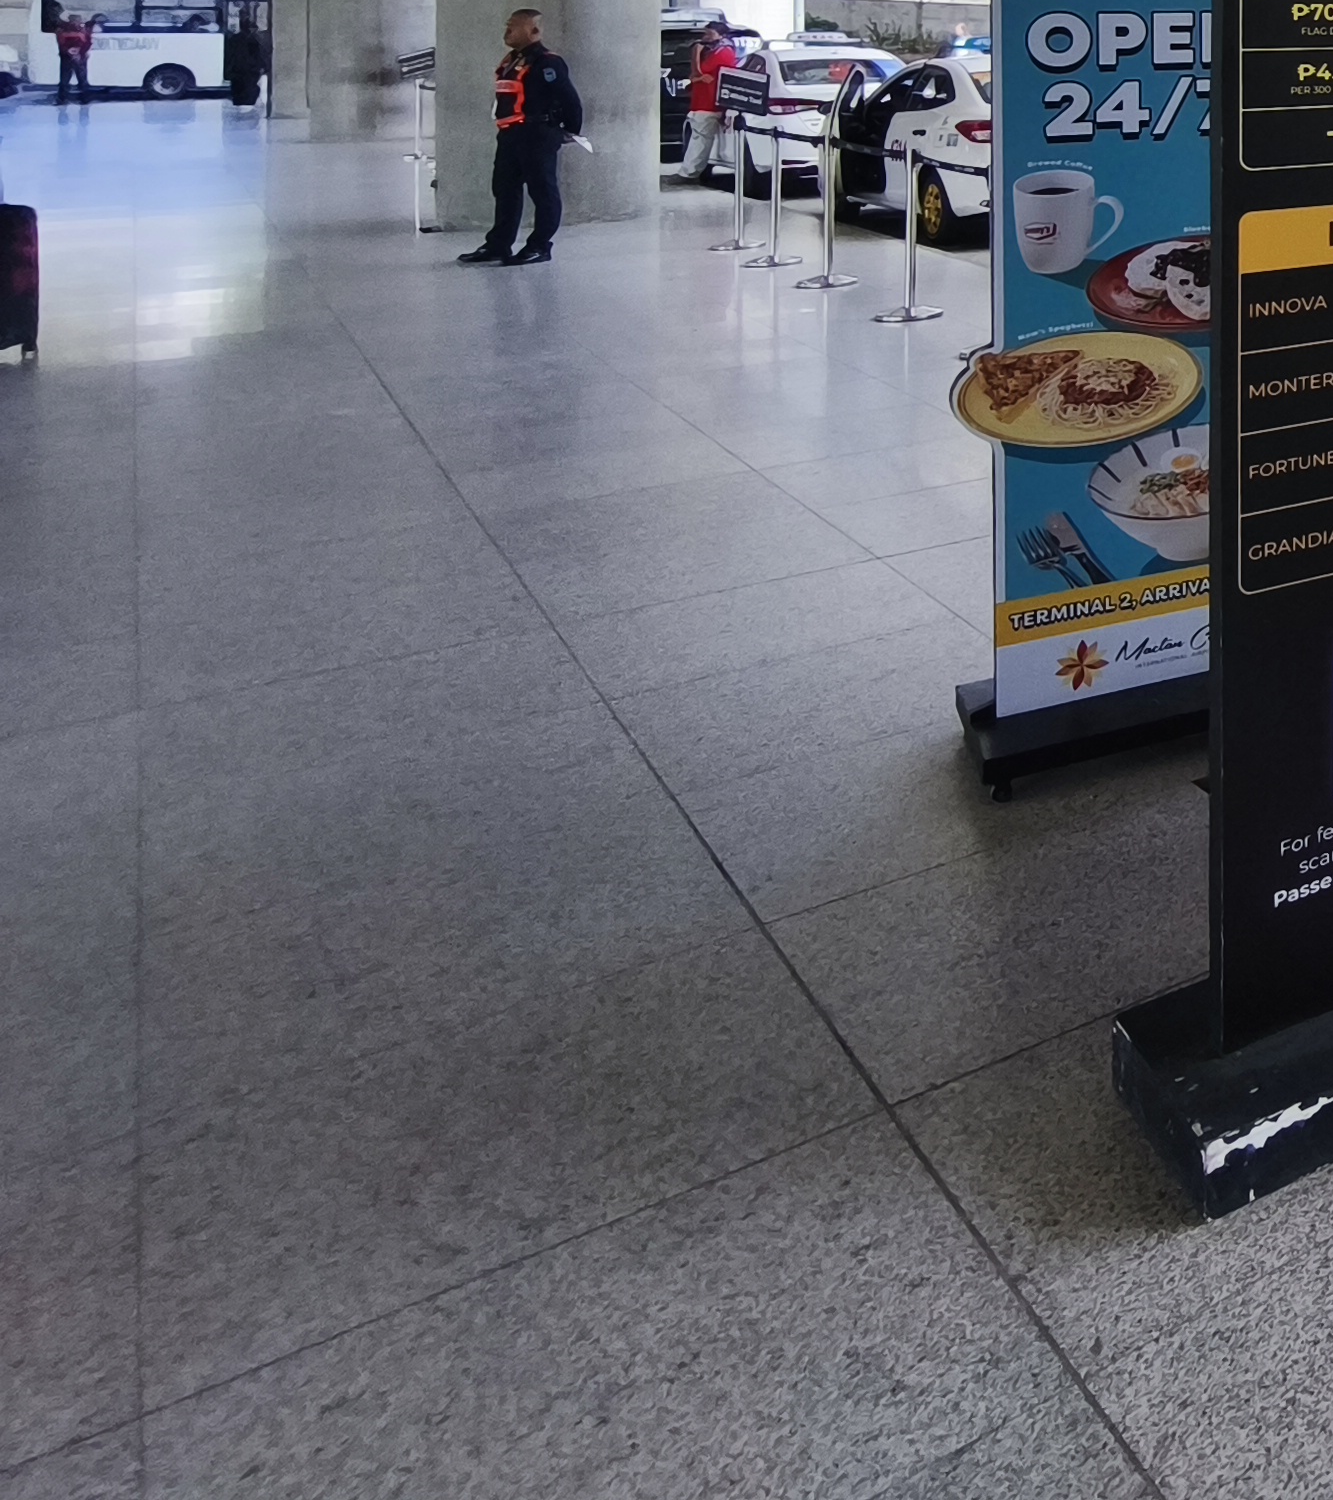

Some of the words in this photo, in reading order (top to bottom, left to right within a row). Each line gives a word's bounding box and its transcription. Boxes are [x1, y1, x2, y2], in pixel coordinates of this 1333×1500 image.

[1301, 26, 1328, 36] FLAG
[1290, 85, 1311, 95] PER
[1312, 85, 1332, 95] 300
[1248, 294, 1328, 319] INNOVA
[1009, 596, 1115, 632] TERMINAL
[1118, 593, 1138, 611] 2,
[1279, 833, 1312, 857] For
